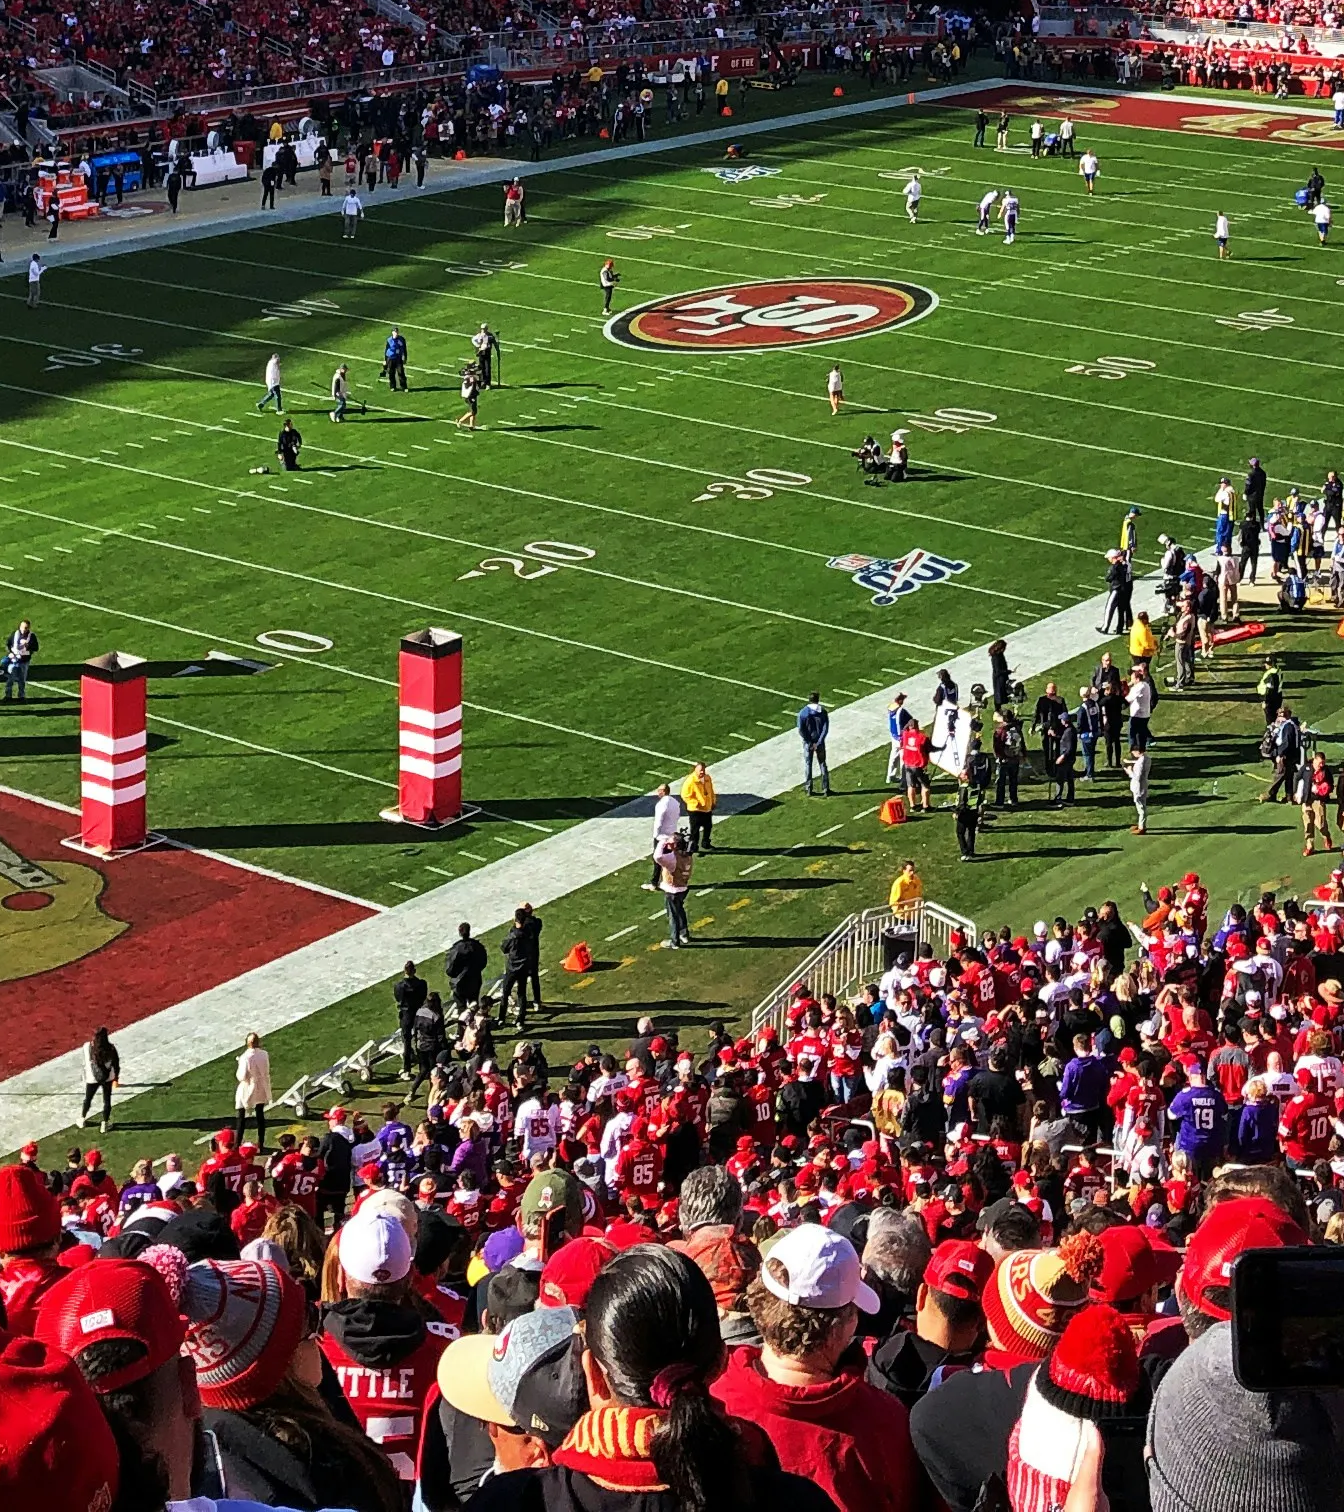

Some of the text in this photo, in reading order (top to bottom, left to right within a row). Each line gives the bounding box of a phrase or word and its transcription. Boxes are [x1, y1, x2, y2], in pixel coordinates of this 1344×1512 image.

[478, 539, 596, 581] 20
[529, 1119, 551, 1138] 85
[1193, 1107, 1215, 1130] 19
[1310, 1119, 1328, 1141] 10
[292, 1174, 315, 1196] 16
[632, 1163, 654, 1186] 85
